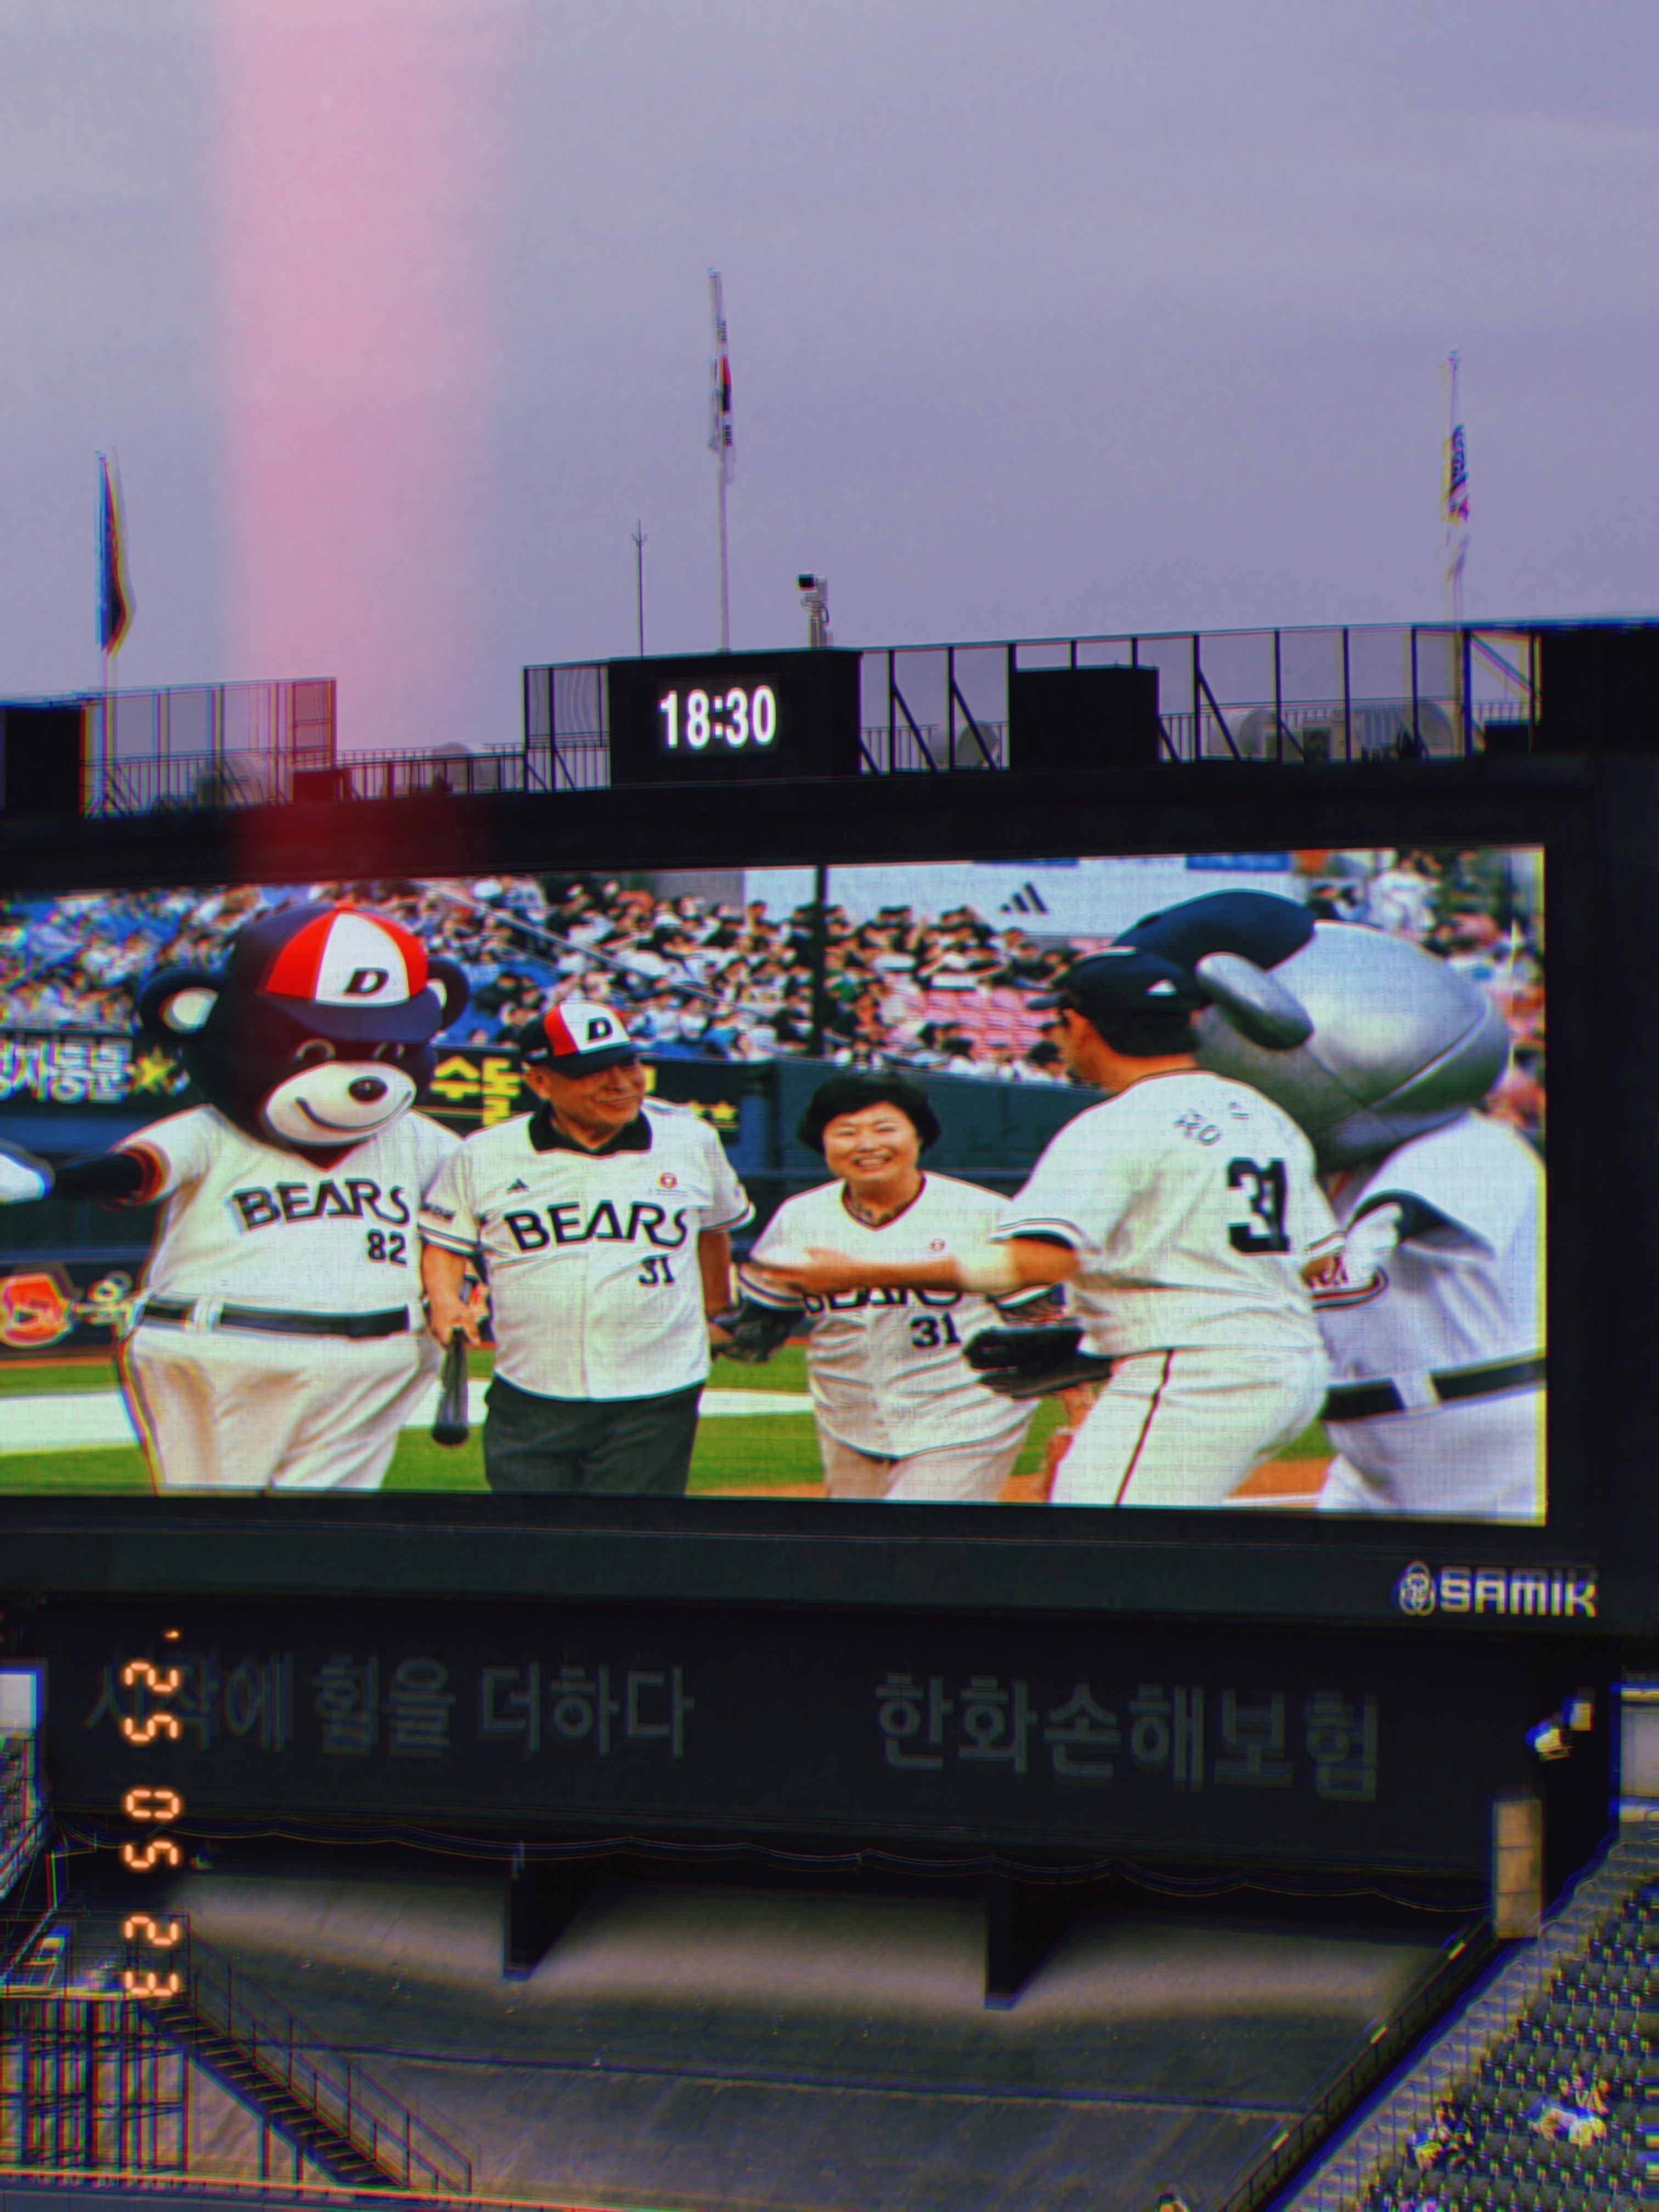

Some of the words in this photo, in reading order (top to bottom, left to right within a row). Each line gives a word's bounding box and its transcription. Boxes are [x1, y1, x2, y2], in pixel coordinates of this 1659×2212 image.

[659, 685, 776, 749] 18:30
[343, 967, 389, 997] D
[586, 1017, 613, 1043] D
[232, 1178, 410, 1230] BEARS
[504, 1200, 687, 1252] BEARS
[1227, 1156, 1289, 1254] 31
[365, 1230, 408, 1267] 82
[909, 1311, 961, 1350] 31
[1440, 1567, 1599, 1617] SAMIK
[313, 1652, 456, 1758] 힘을
[479, 1660, 695, 1760] 더하다
[876, 1671, 1379, 1802] 한화손해보험
